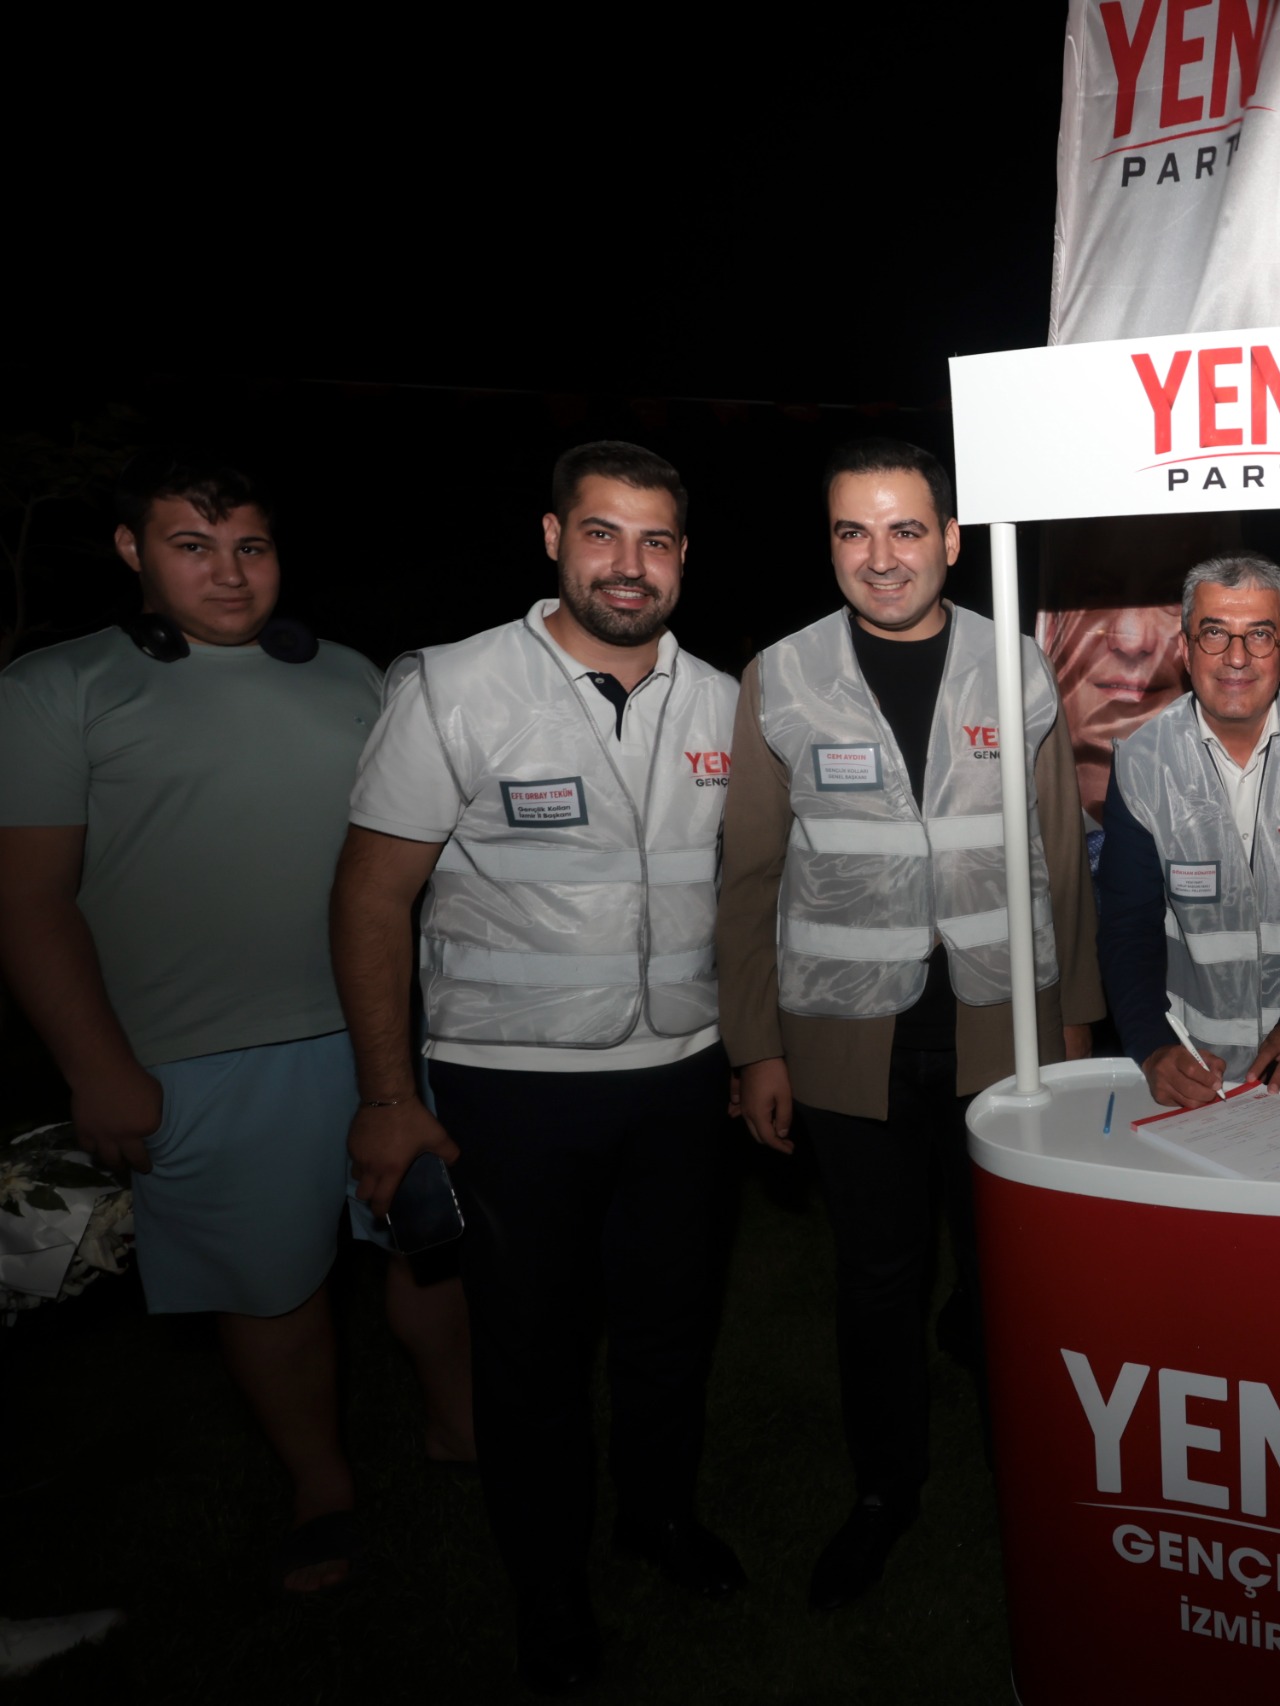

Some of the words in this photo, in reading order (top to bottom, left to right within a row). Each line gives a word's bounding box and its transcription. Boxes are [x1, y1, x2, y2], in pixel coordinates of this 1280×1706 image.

[1099, 0, 1279, 139] YEN
[1121, 131, 1242, 187] PART
[962, 725, 999, 747] YE
[684, 751, 732, 774] YEN
[695, 777, 729, 788] GENÇ
